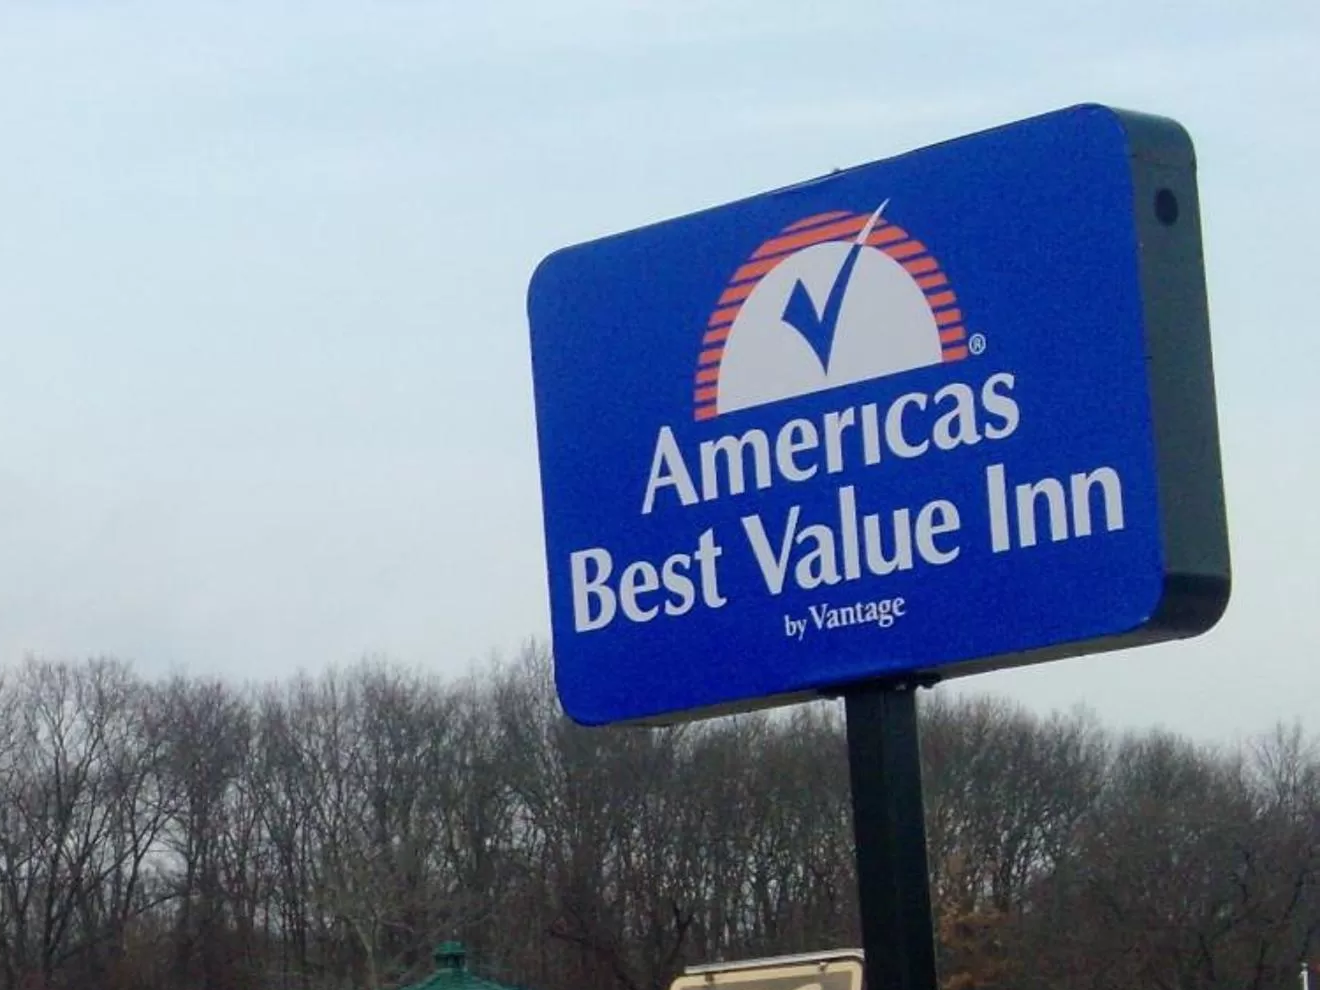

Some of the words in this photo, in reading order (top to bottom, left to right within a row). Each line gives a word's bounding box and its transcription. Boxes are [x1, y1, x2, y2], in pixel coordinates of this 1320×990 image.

[641, 371, 1020, 515] Americas
[569, 529, 727, 633] Best
[741, 486, 960, 597] Value
[987, 463, 1125, 553] Inn
[784, 613, 808, 642] by
[808, 596, 907, 632] Vantage
